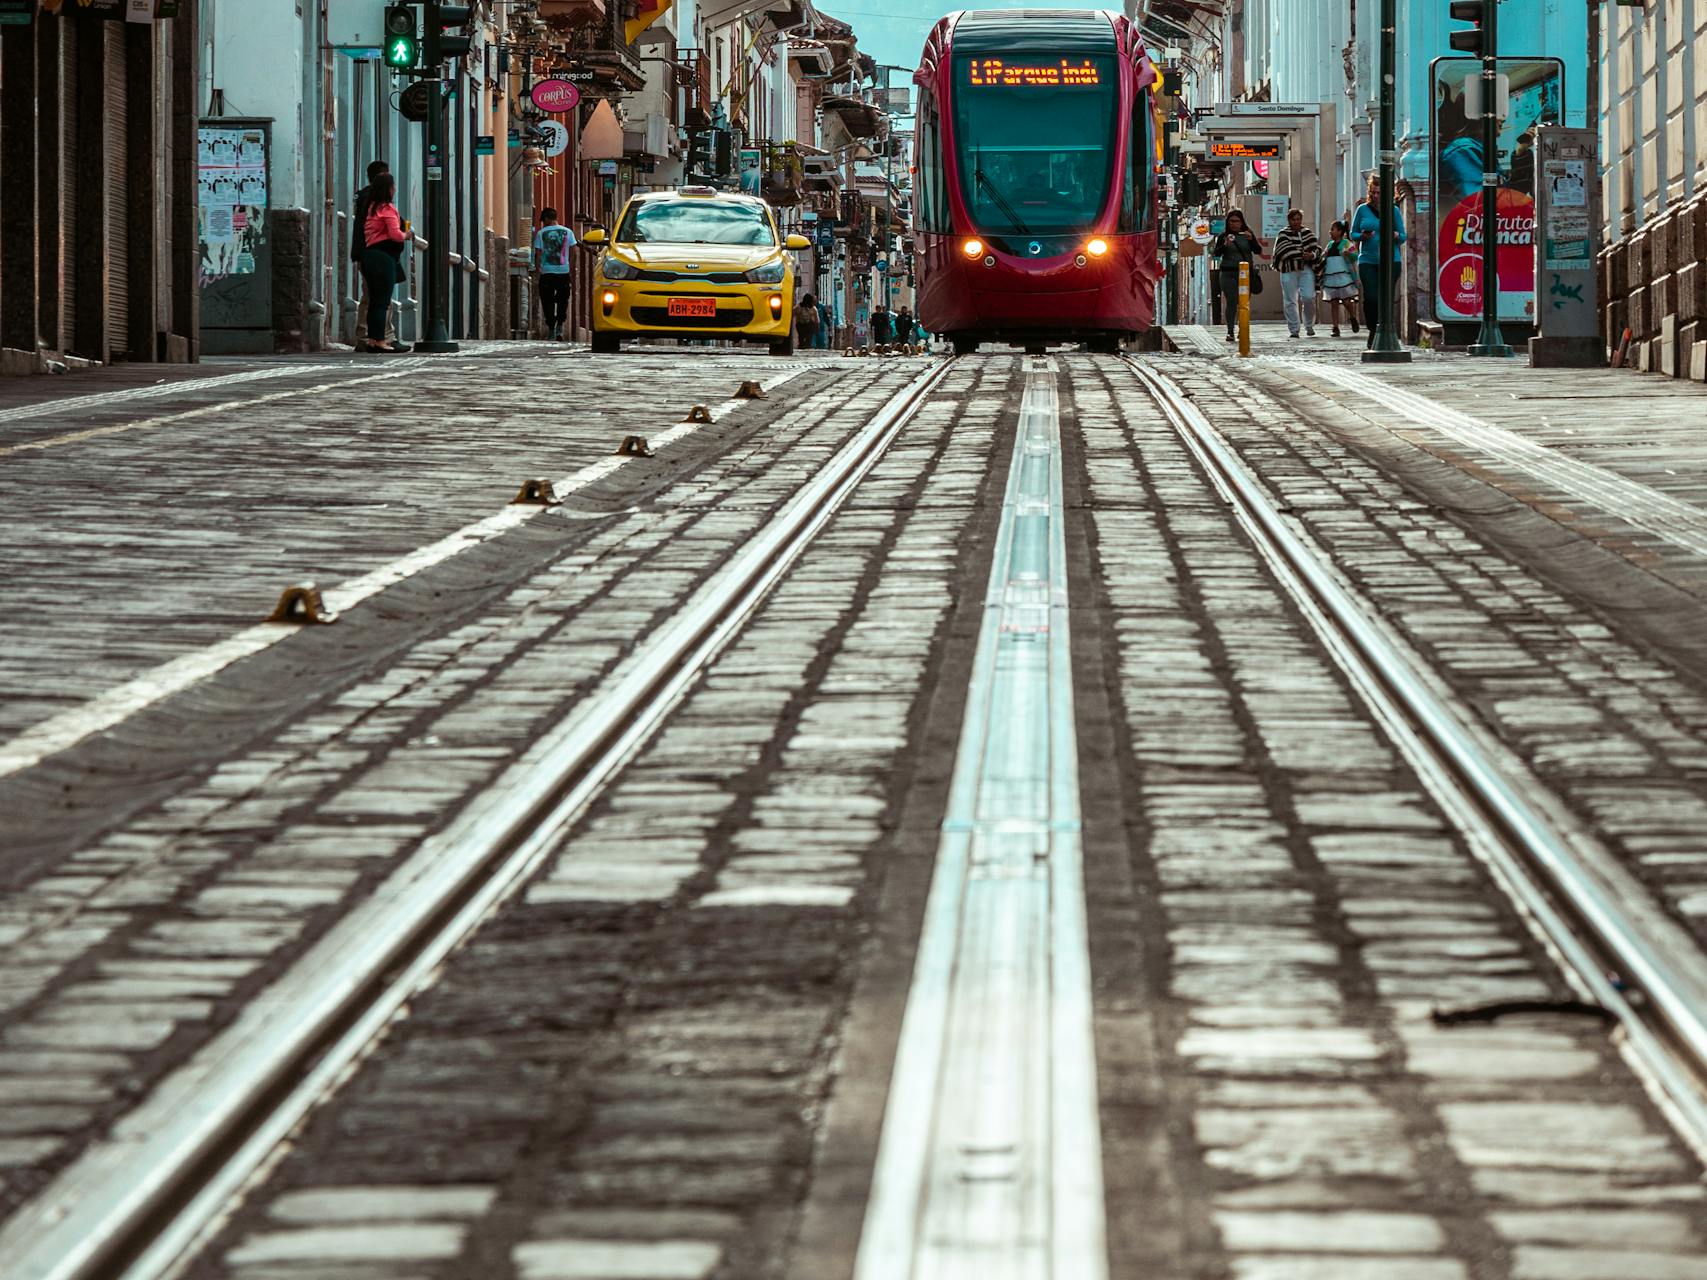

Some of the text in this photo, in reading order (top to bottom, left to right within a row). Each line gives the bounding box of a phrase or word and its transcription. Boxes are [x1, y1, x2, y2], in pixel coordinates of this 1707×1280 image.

[93, 2, 113, 10] Union
[538, 86, 572, 105] CORPUS
[1465, 213, 1534, 231] Diruta
